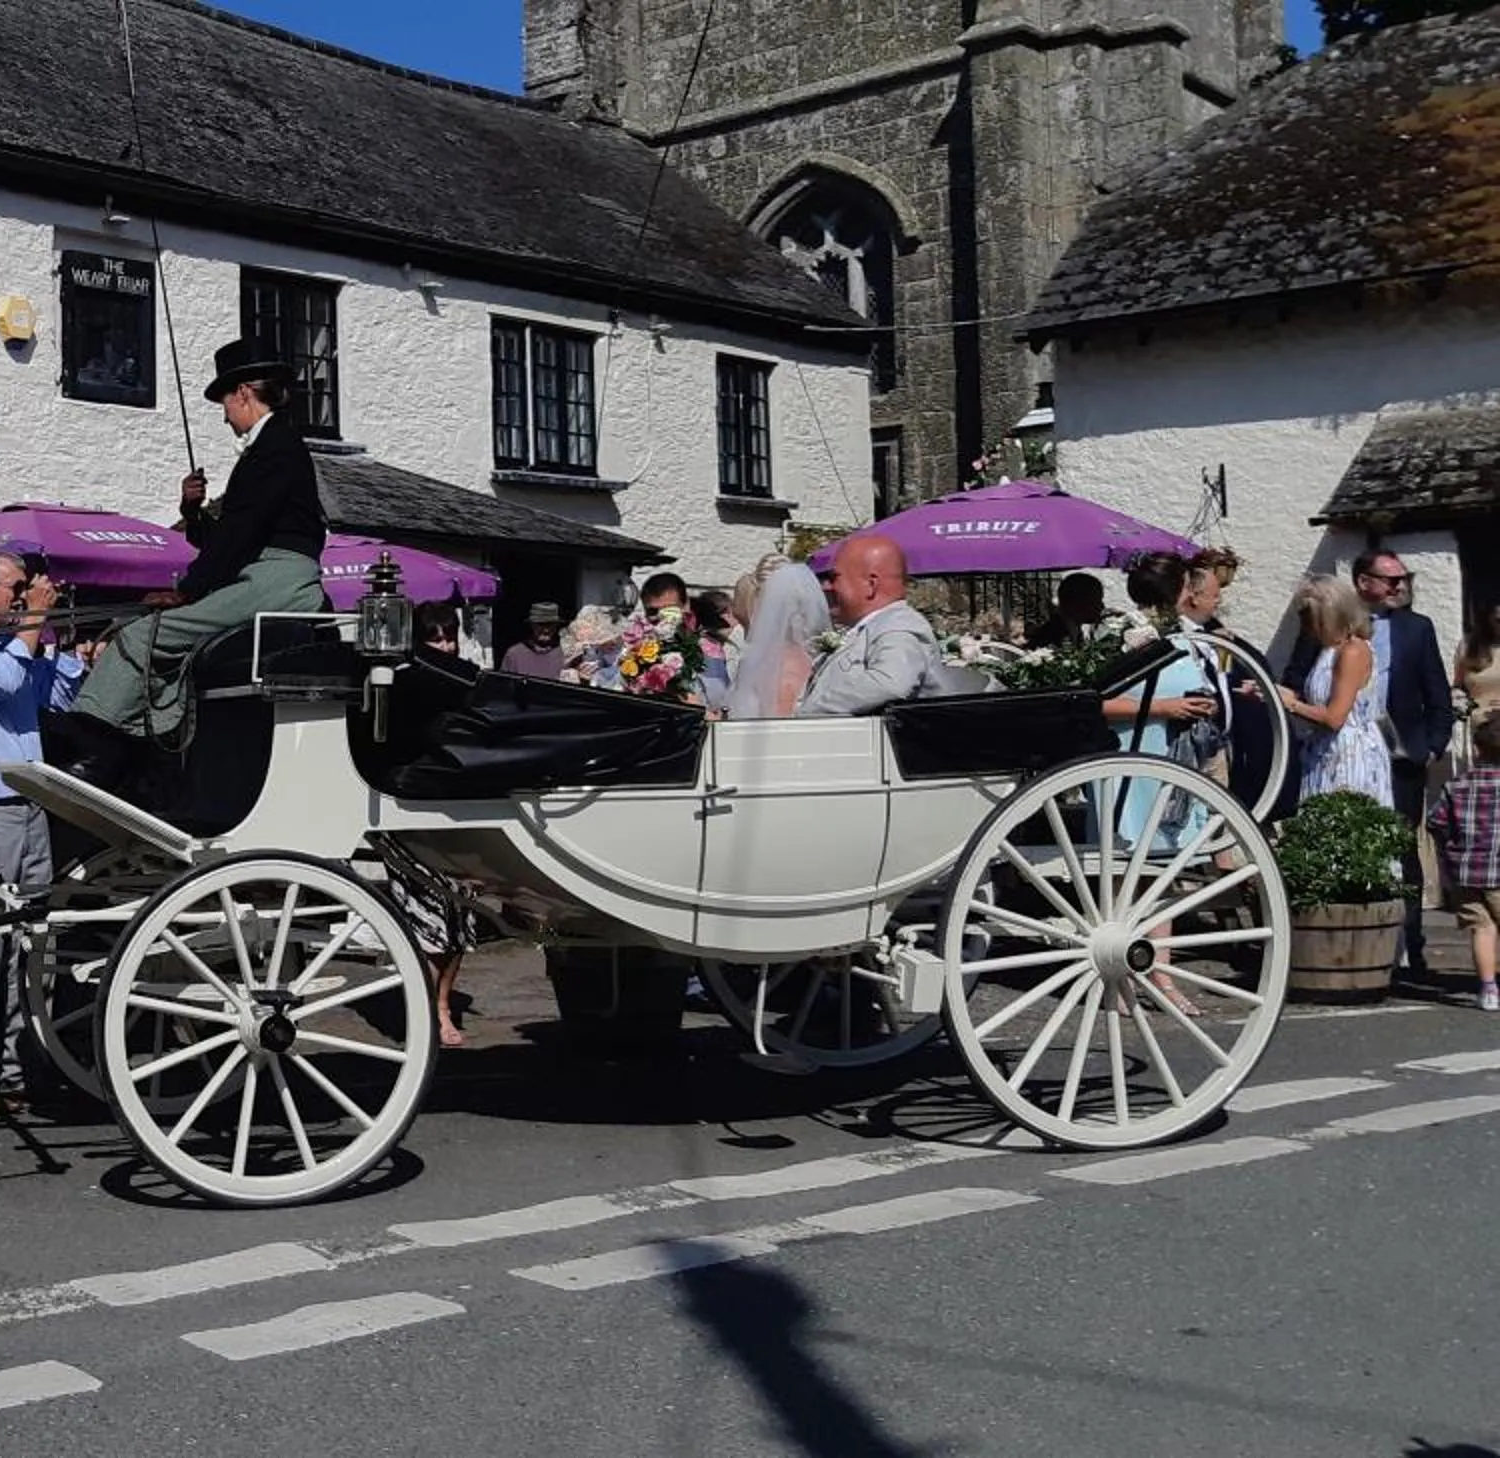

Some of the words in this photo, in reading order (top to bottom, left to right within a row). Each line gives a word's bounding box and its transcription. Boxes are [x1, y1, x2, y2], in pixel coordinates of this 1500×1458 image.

[102, 257, 125, 275] THE
[71, 266, 111, 288] WEARY
[117, 275, 150, 295] FRIAR
[929, 520, 1040, 535] TRIBUTE
[70, 530, 168, 545] TRIBUTE
